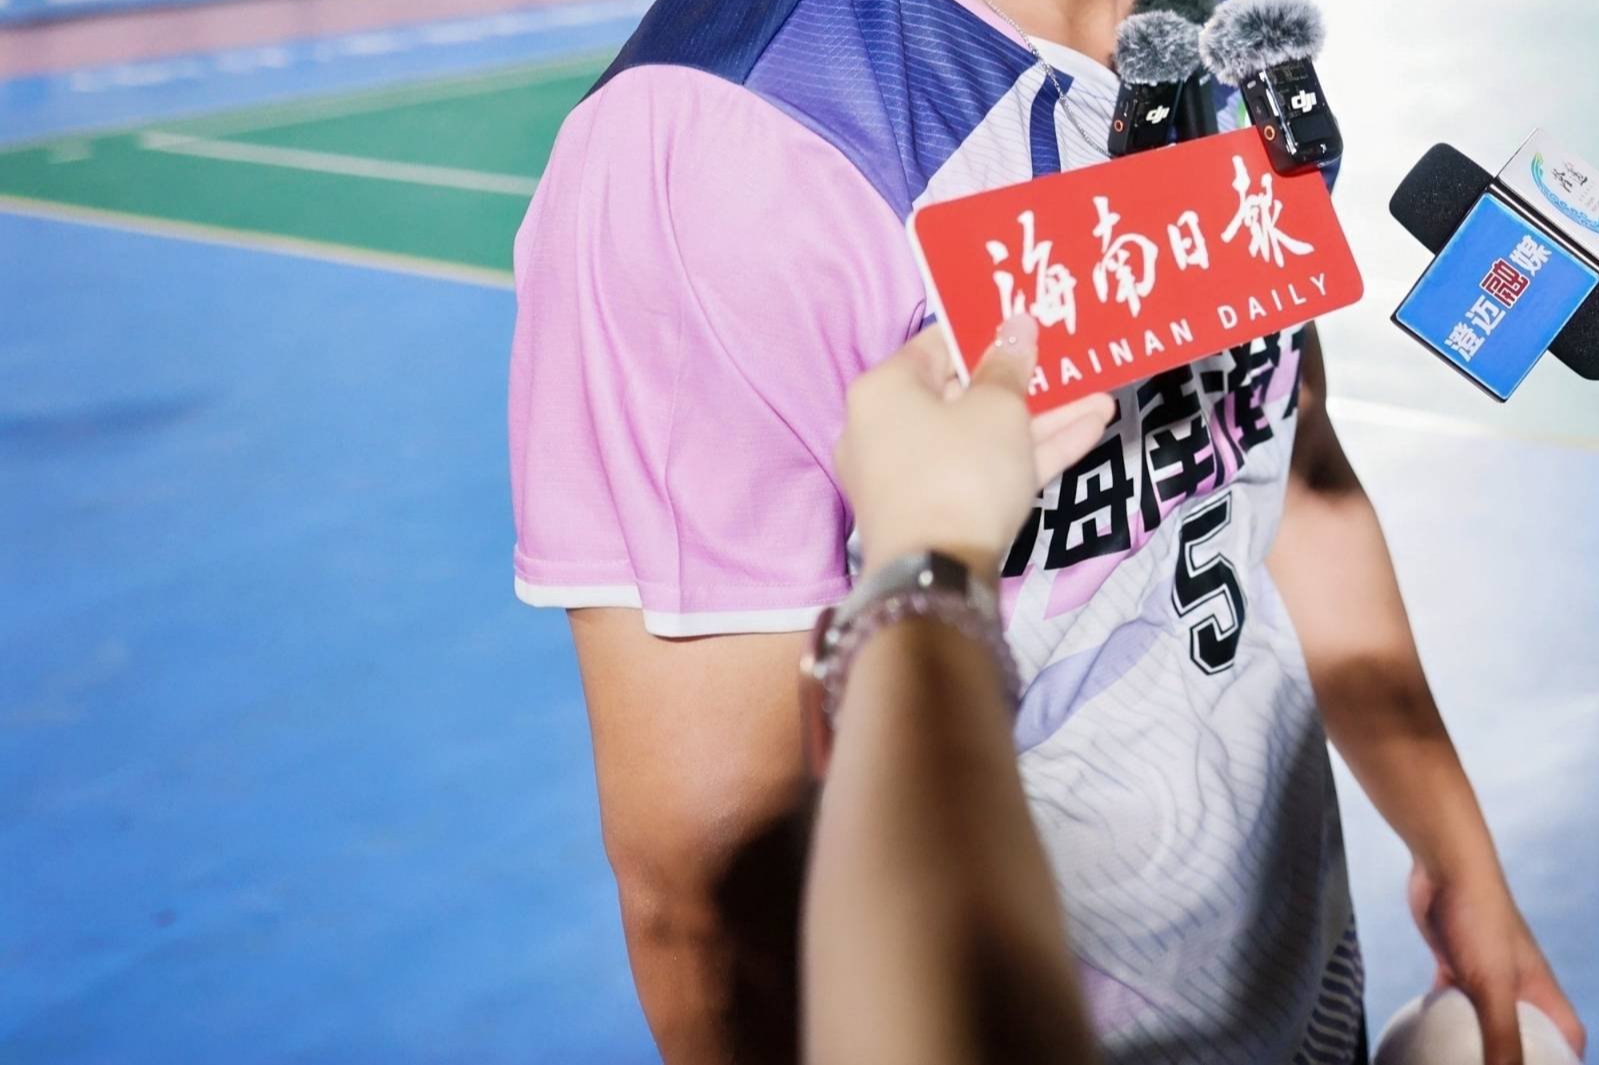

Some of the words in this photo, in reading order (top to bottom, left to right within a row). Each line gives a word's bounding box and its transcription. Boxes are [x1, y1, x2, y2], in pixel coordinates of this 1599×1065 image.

[1028, 318, 1194, 396] HAINAN
[1216, 273, 1328, 330] DAILY
[1443, 234, 1553, 363] 澄迈融媒
[1170, 490, 1248, 677] 5
